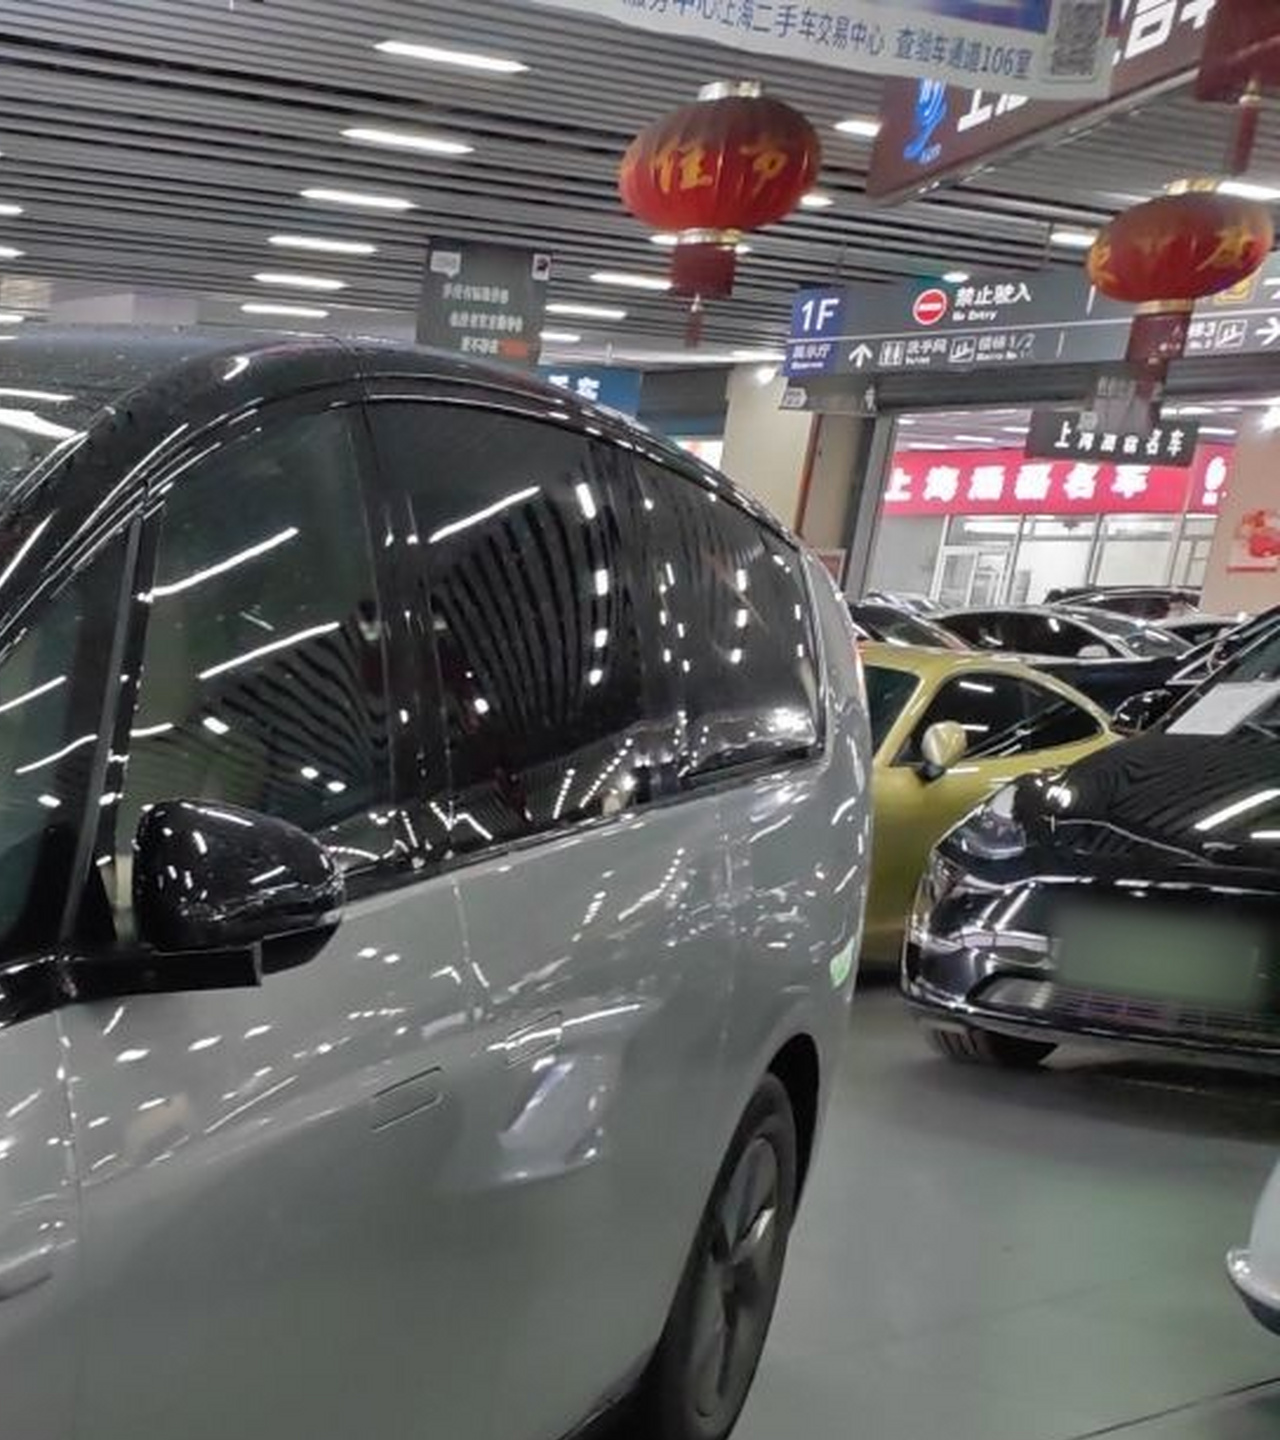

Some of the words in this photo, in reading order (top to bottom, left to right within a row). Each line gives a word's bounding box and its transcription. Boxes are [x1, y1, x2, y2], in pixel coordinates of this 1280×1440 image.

[954, 282, 1032, 307] 禁止驶入
[801, 298, 839, 331] 1F
